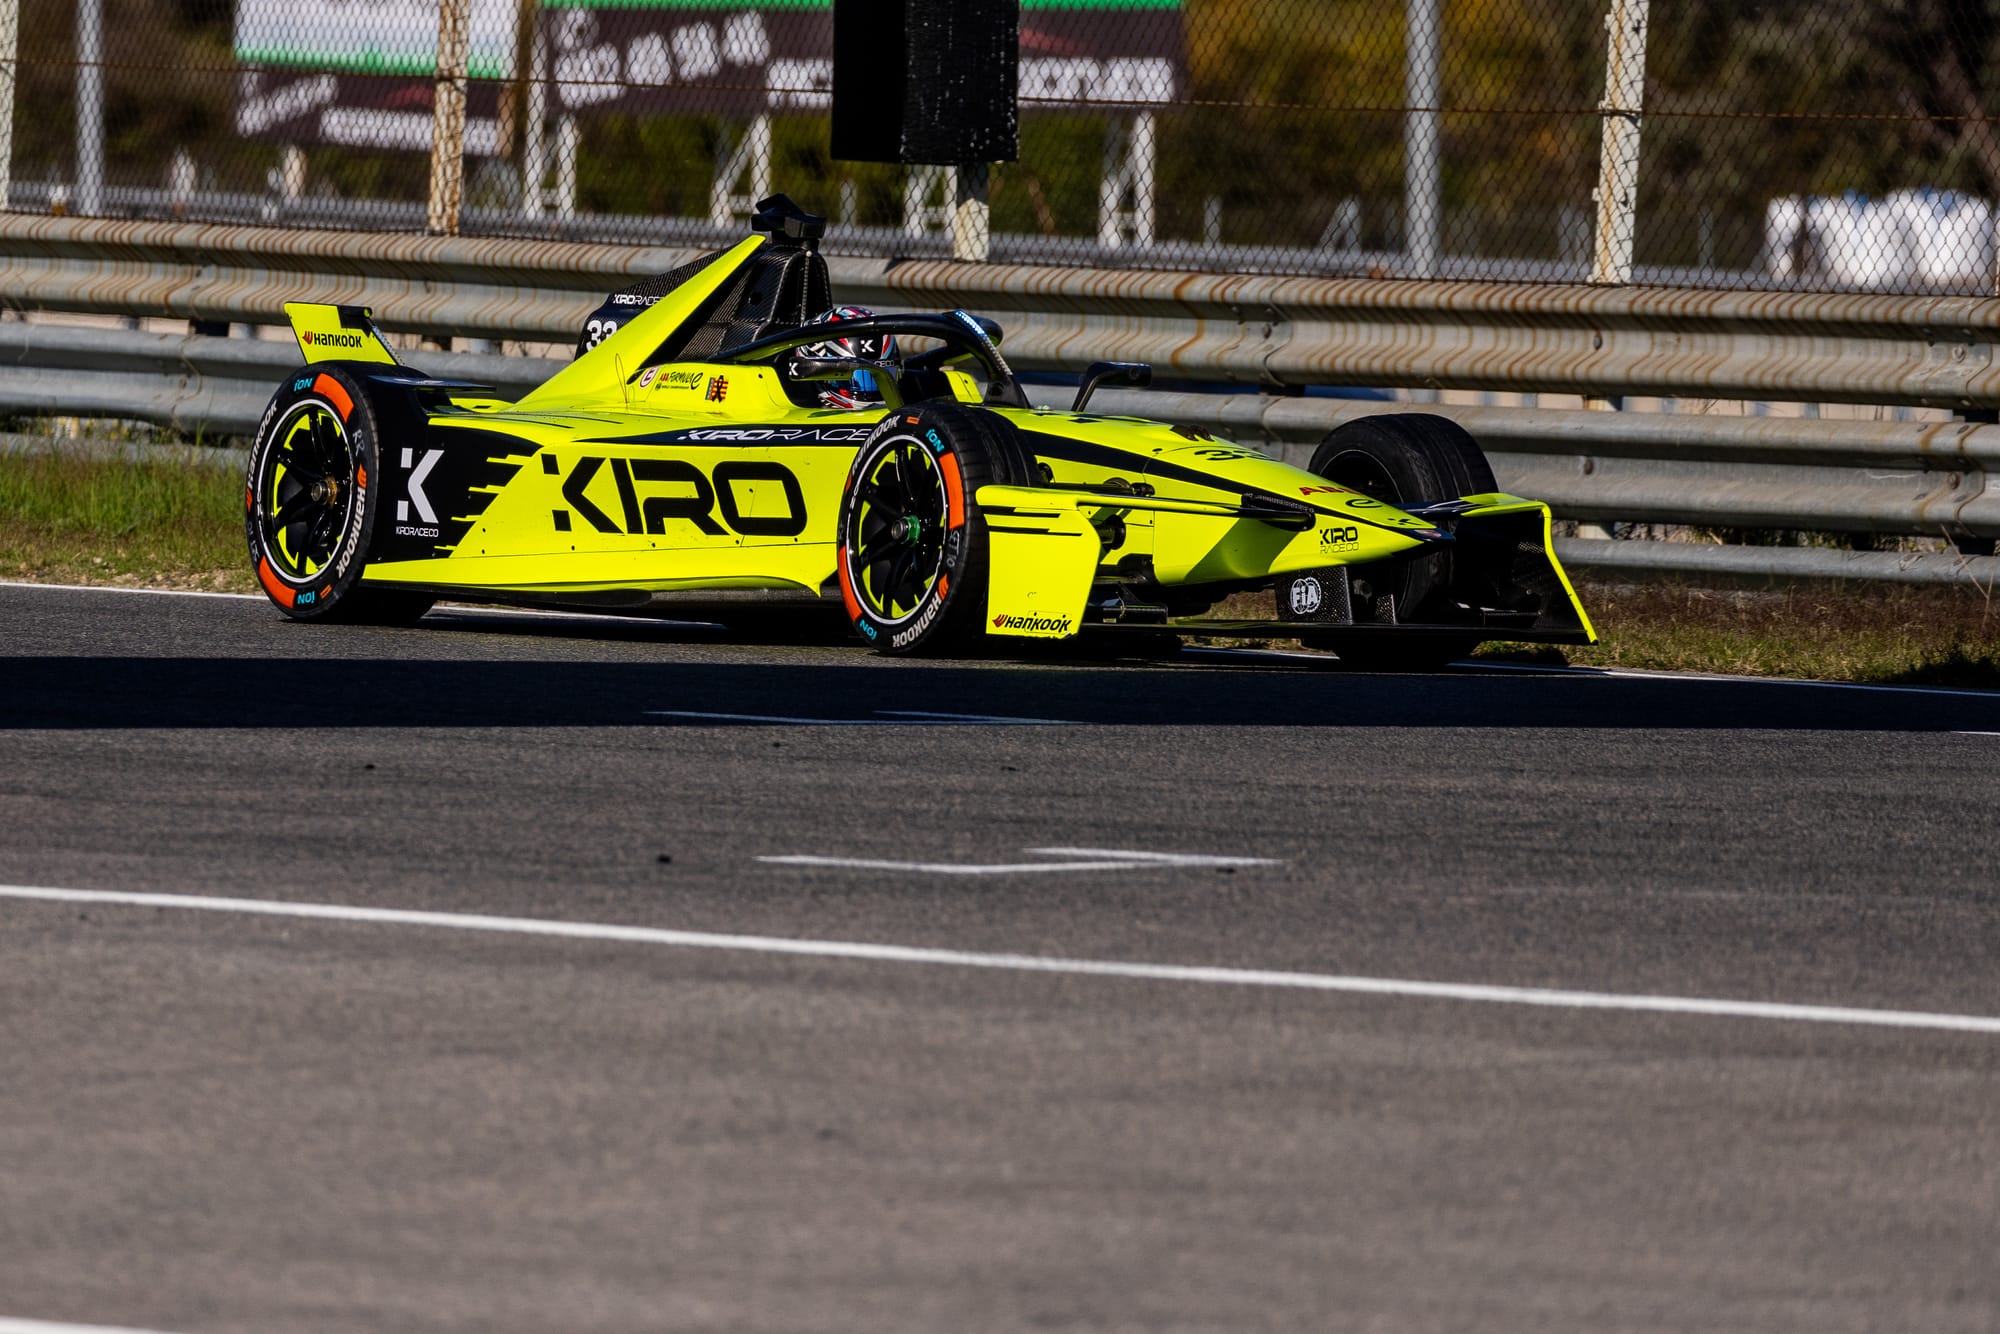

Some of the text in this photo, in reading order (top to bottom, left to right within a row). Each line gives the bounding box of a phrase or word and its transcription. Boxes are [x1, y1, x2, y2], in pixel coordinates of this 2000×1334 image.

[397, 447, 445, 524] K
[541, 453, 808, 537] KIRO
[1319, 526, 1359, 545] KIRO
